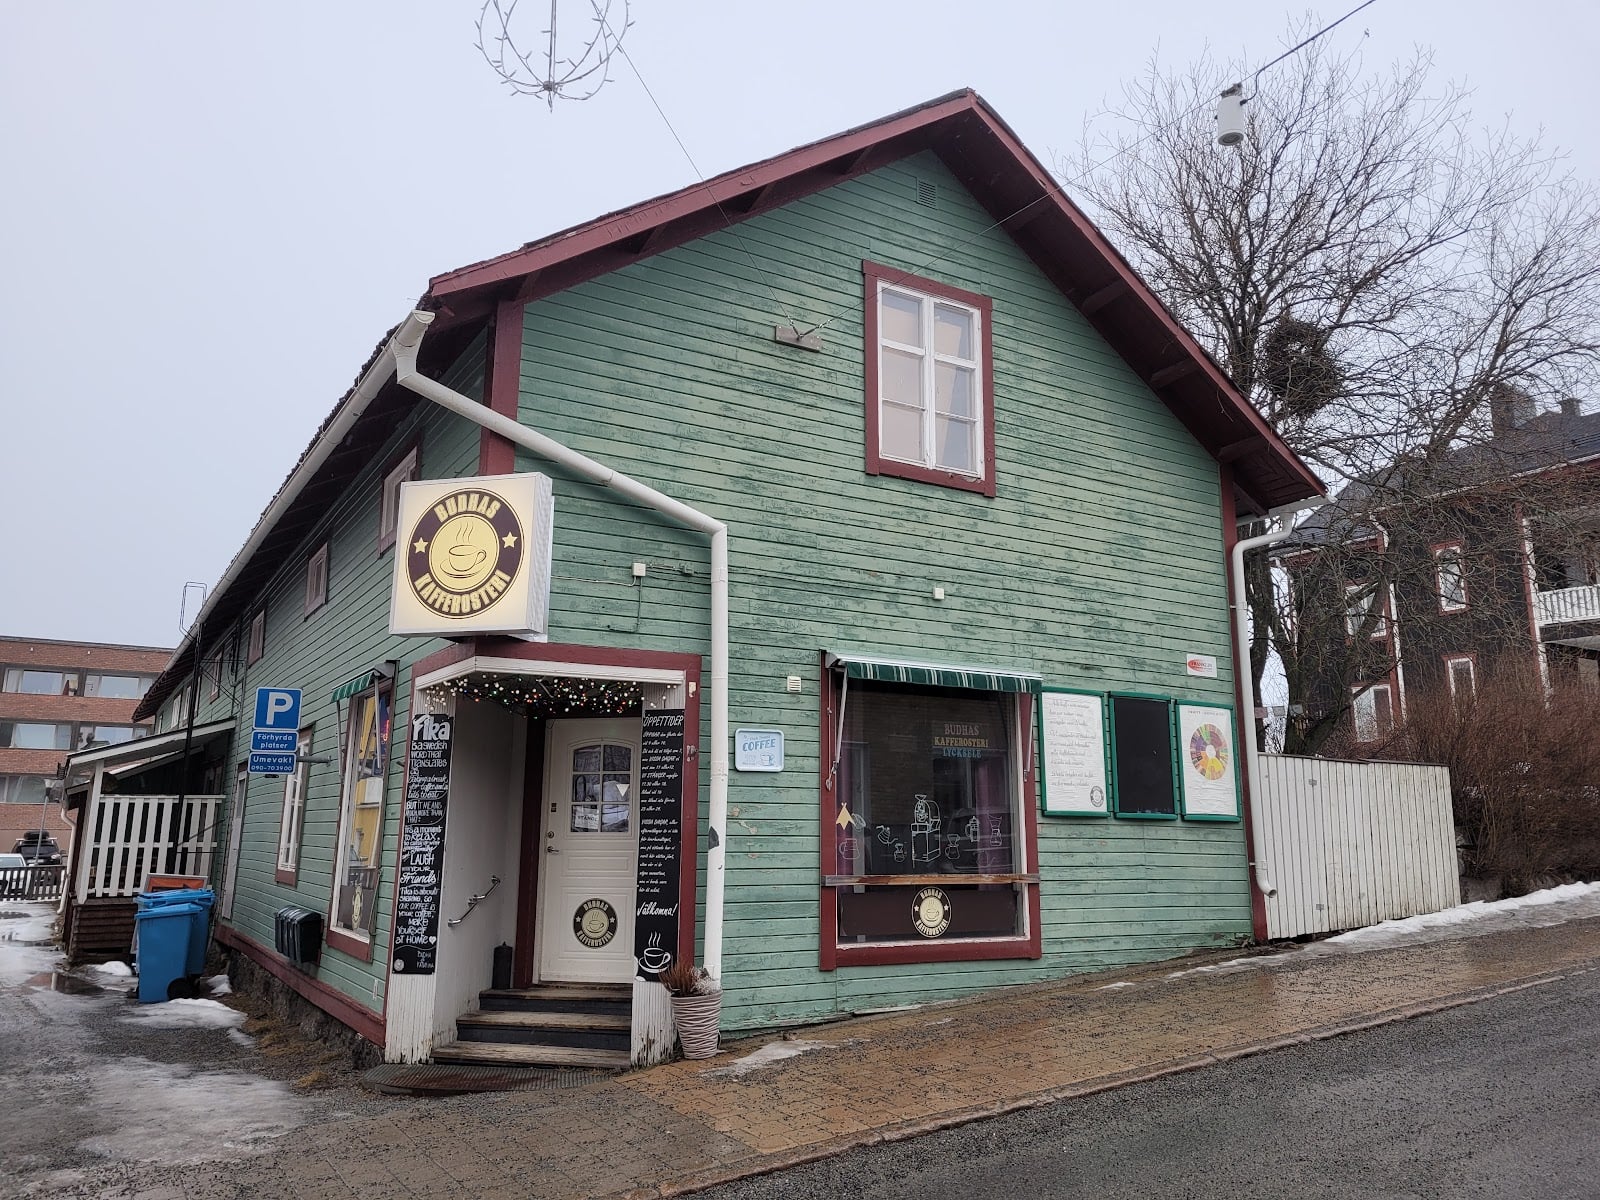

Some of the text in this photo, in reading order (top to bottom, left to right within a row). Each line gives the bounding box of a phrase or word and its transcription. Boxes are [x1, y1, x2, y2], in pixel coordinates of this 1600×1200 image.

[433, 493, 502, 523] BUDHAS
[414, 569, 512, 614] KAFFEROSTERI
[266, 691, 294, 725] P
[643, 713, 684, 728] ÖPPETTIDER
[944, 723, 980, 736] BUDHAS
[257, 733, 293, 743] Förhyrda
[934, 736, 989, 748] KAFFEROSTERI
[260, 742, 288, 750] platser
[742, 738, 777, 752] COFFEE
[943, 746, 982, 758] LYCKSELE
[253, 755, 292, 763] Umevakt
[406, 800, 417, 810] BUT
[410, 853, 435, 866] LAUGH
